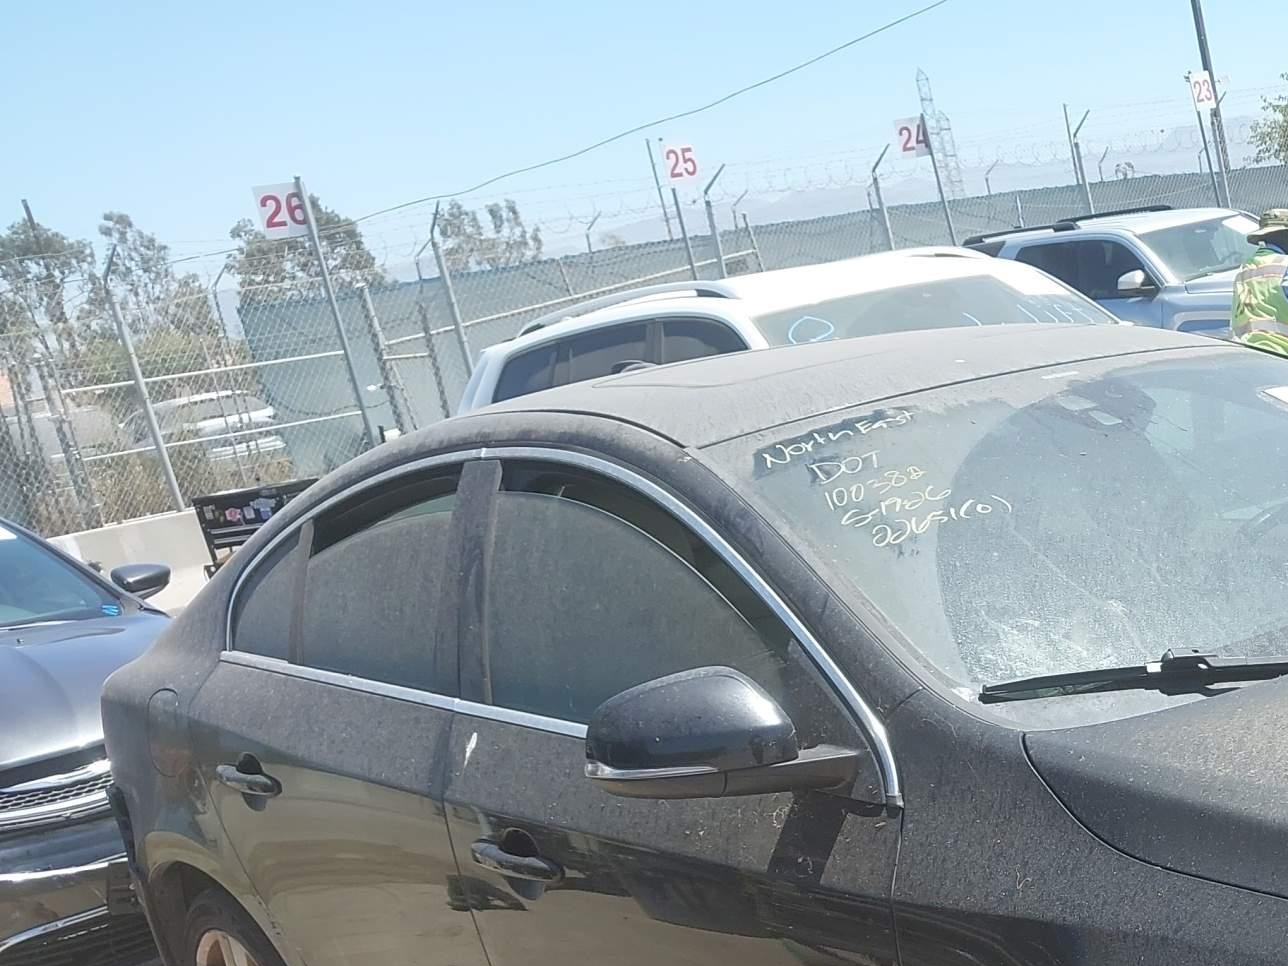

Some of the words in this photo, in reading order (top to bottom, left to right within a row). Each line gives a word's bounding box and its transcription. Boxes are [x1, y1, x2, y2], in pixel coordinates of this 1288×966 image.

[1193, 79, 1213, 103] 23
[899, 124, 930, 152] 24
[666, 146, 697, 178] 25
[260, 191, 308, 228] 26
[808, 450, 880, 484] DOT
